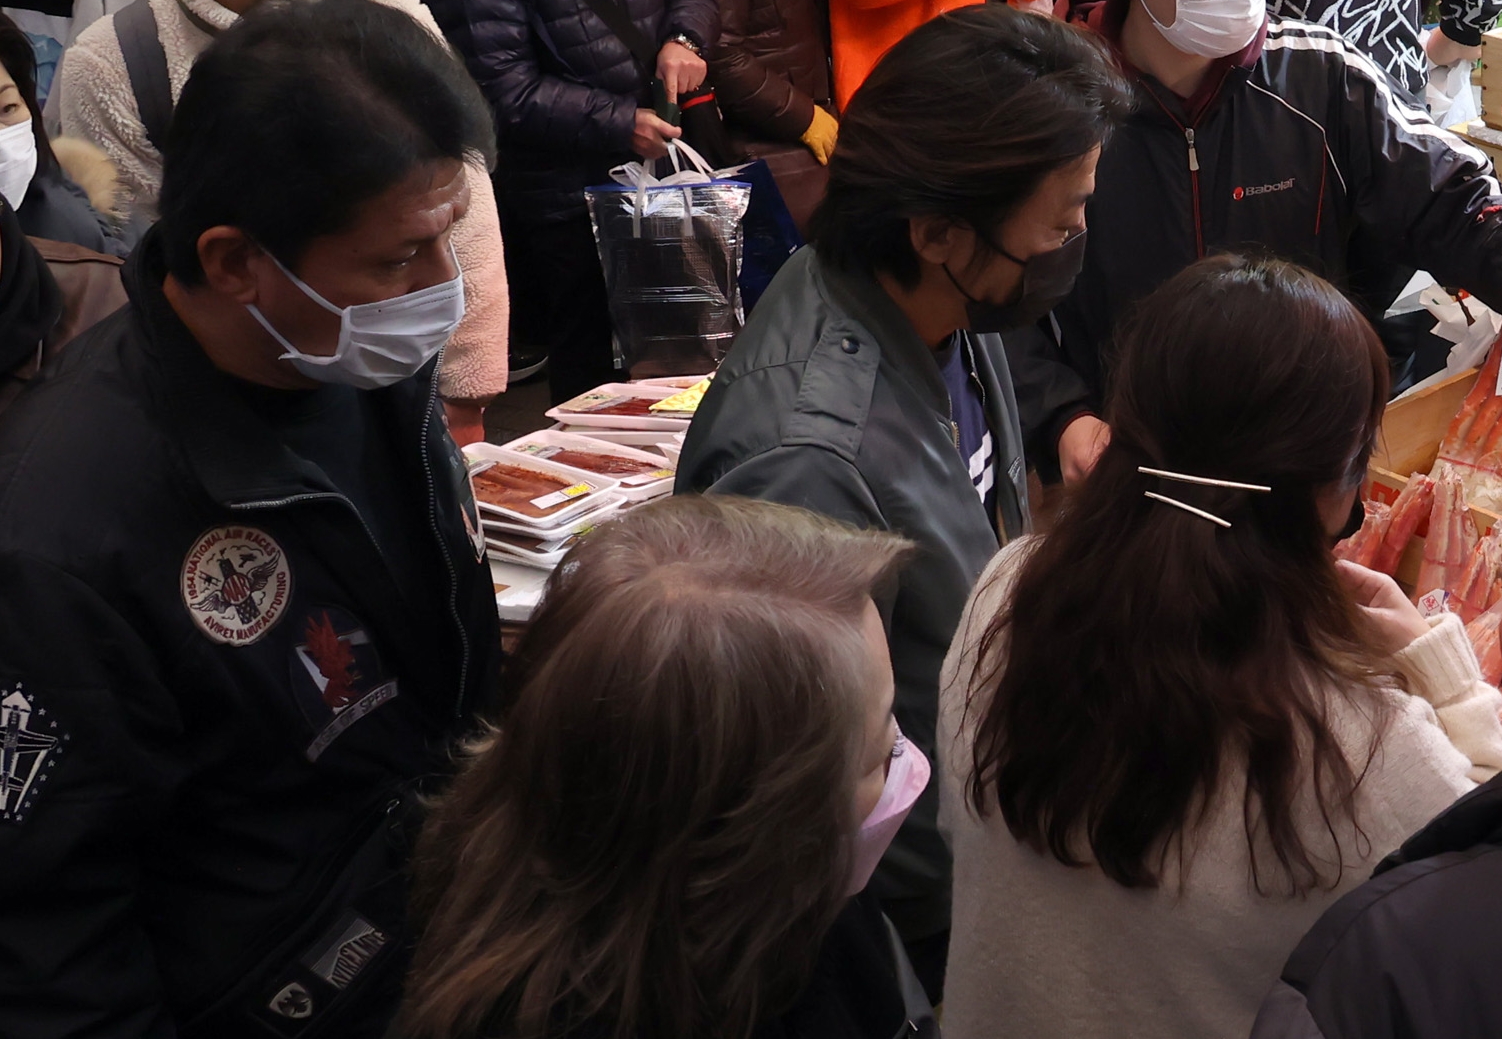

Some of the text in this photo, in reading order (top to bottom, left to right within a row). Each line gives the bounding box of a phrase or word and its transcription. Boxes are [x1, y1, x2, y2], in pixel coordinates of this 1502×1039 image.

[187, 531, 223, 575] NATIONAL
[224, 528, 243, 540] AIR
[244, 530, 277, 557] RACES
[204, 571, 287, 640] AVIREX MANUFACTURING
